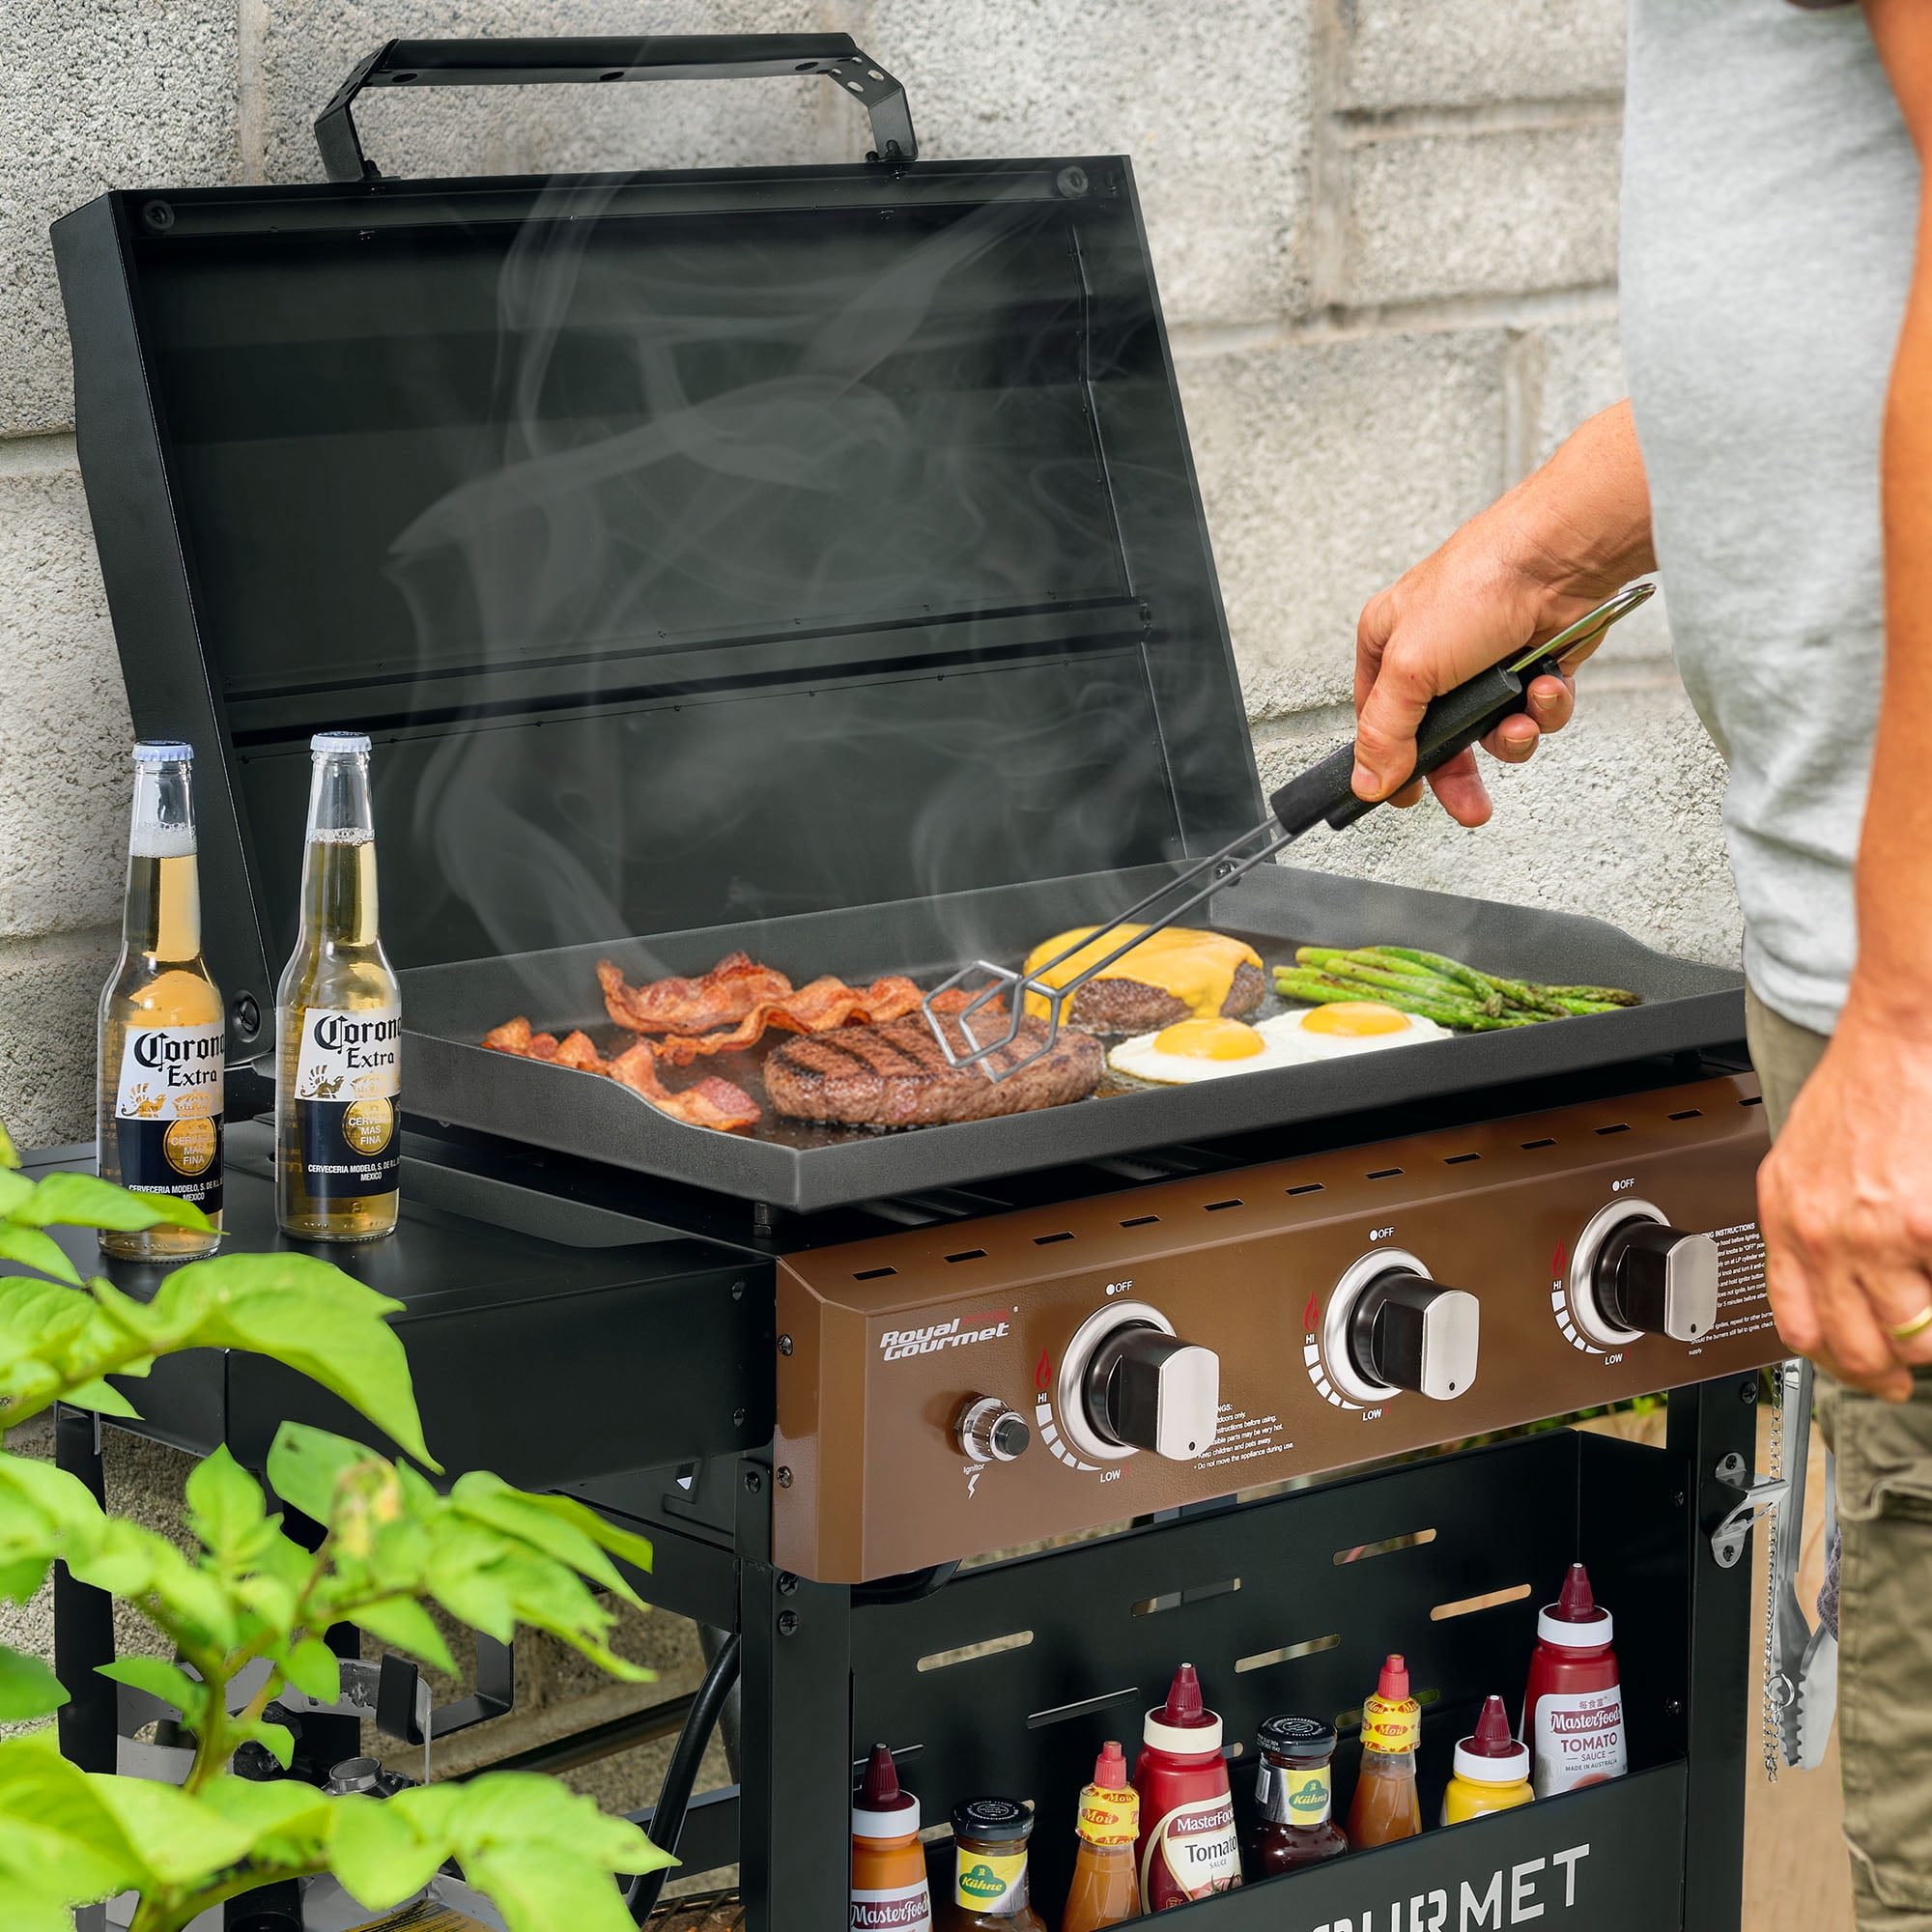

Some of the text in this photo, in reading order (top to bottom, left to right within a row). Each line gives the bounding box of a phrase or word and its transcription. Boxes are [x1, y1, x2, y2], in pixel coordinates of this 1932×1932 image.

[346, 1047, 394, 1069] Extra
[167, 1065, 217, 1087] Extra
[359, 1135, 382, 1145] FINA
[183, 1155, 205, 1165] FINA
[308, 1164, 349, 1174] CERVECERIA
[360, 1172, 383, 1181] MEXICO
[128, 1184, 171, 1194] CERVECERIA
[1619, 1178, 1635, 1190] OFF
[183, 1192, 206, 1202] MEXICO
[1378, 1226, 1395, 1239] OFF
[1715, 1222, 1755, 1237] INSTRUCTIONS
[1115, 1280, 1133, 1293] OFF
[1553, 1280, 1562, 1291] HI
[880, 1318, 961, 1349] Royal
[1305, 1333, 1315, 1345] HI
[883, 1322, 1010, 1362] Gourmet
[1605, 1352, 1623, 1366] LOW
[1037, 1392, 1047, 1404] HI
[1362, 1408, 1382, 1422] LOW
[1244, 1419, 1261, 1428] before
[1261, 1426, 1273, 1435] very
[1212, 1446, 1234, 1456] children
[1234, 1442, 1244, 1451] and
[1207, 1460, 1215, 1468] not
[1215, 1457, 1231, 1465] move
[1231, 1454, 1239, 1463] the
[1240, 1449, 1265, 1461] appliance
[1265, 1444, 1283, 1454] during
[963, 1463, 984, 1475] Ignitor
[1099, 1469, 1122, 1483] LOW
[1561, 1732, 1618, 1752] TOMATO
[1581, 1750, 1605, 1762] SAUCE
[1591, 1758, 1618, 1769] AUSTRALIA
[1177, 1807, 1234, 1832] MasterFoo
[1184, 1835, 1236, 1863] Tomato
[1209, 1859, 1228, 1870] SAUCE
[961, 1876, 1003, 1891] Kühne
[851, 1892, 927, 1926] MasterFood
